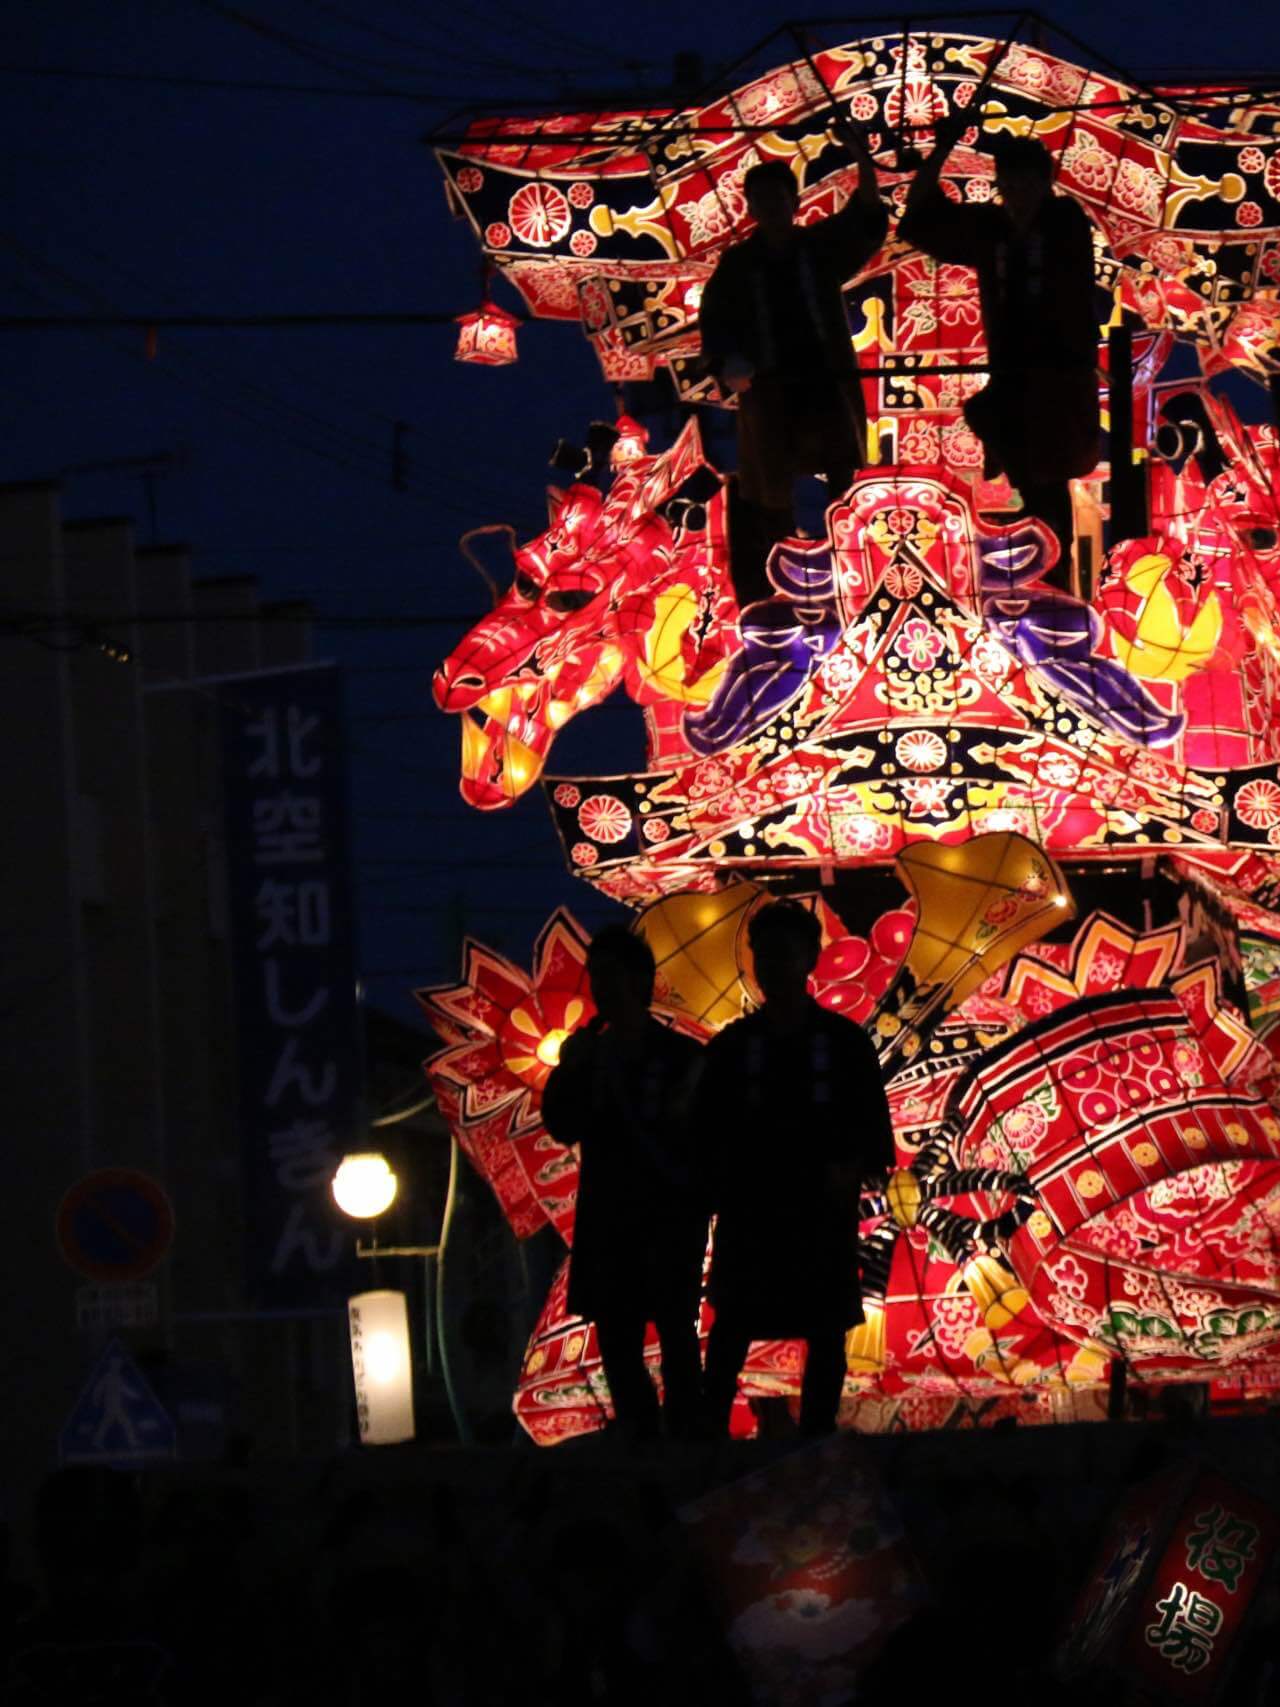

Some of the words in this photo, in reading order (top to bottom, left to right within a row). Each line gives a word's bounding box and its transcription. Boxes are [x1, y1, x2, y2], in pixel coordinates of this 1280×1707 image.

[245, 705, 344, 1276] 北空知しんきん
[1144, 1502, 1261, 1675] 役場
